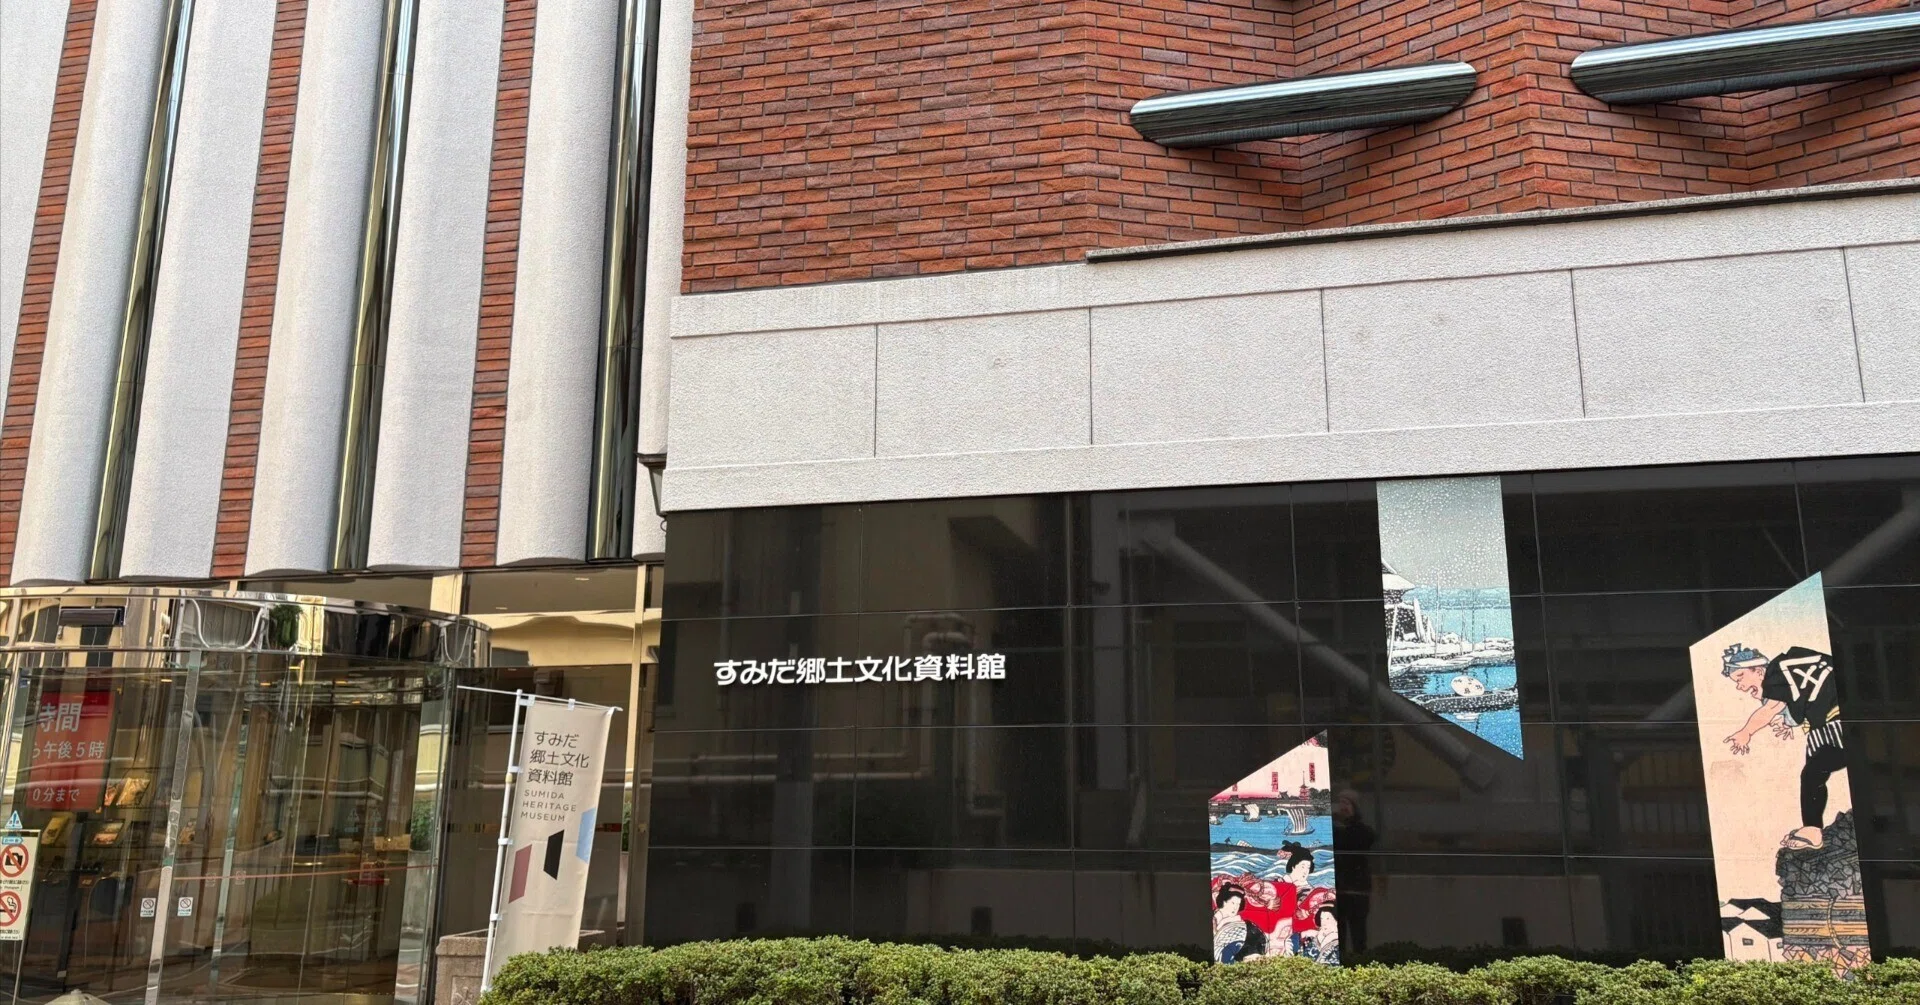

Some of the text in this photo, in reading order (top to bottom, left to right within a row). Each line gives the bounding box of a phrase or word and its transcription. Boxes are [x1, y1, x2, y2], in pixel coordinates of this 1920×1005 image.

[714, 653, 1006, 686] すみだ郷土文化資料館
[534, 731, 580, 749] すみだ
[529, 748, 590, 769] 郷土文化
[526, 768, 574, 786] 資料館
[523, 789, 565, 800] SUMIDA
[522, 801, 577, 812] HERITAGE
[520, 811, 566, 822] MUSEUM
